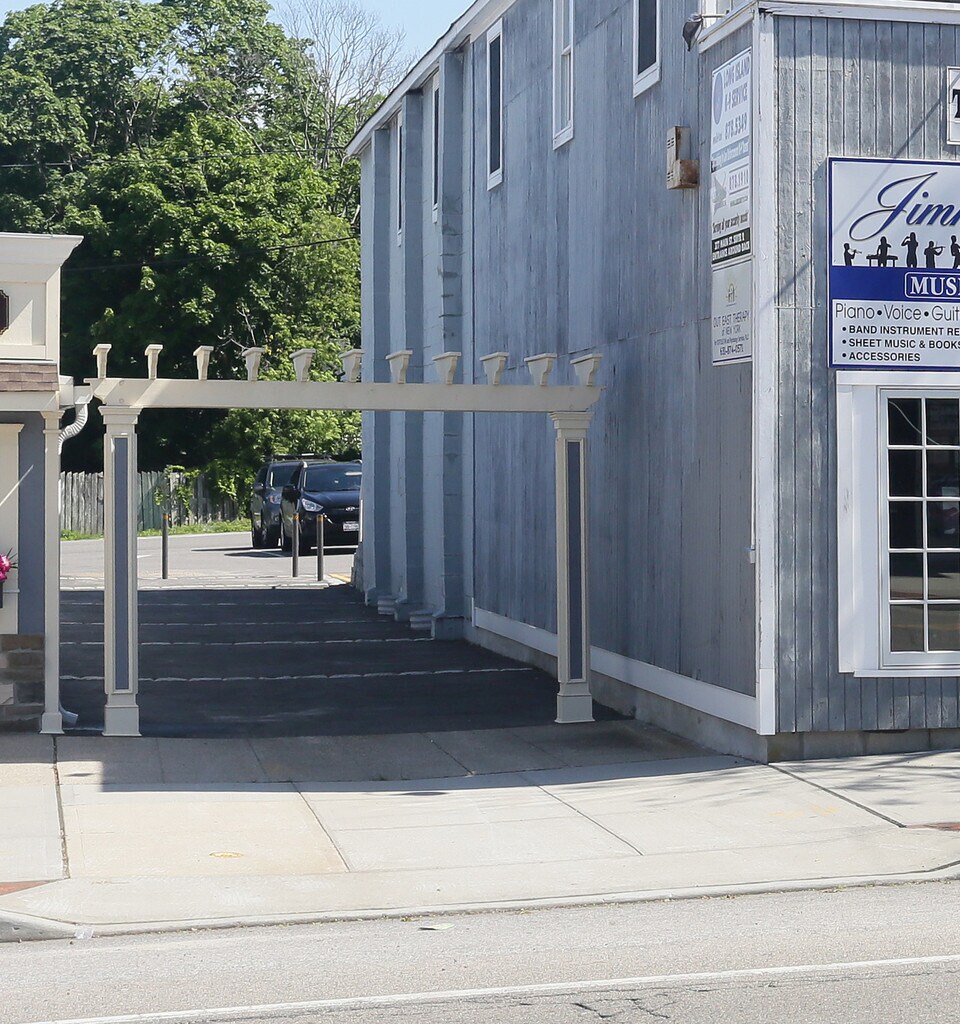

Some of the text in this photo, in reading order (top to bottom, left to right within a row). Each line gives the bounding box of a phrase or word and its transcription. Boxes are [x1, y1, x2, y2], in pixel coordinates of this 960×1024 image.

[835, 302, 875, 319] Piano
[884, 304, 922, 320] Voice
[849, 326, 877, 335] BAND
[880, 326, 944, 336] INSTRUMENT
[849, 339, 882, 347] SHEET
[885, 339, 915, 348] MUSIC
[919, 340, 926, 349] &
[849, 352, 921, 362] ACCESSORIES
